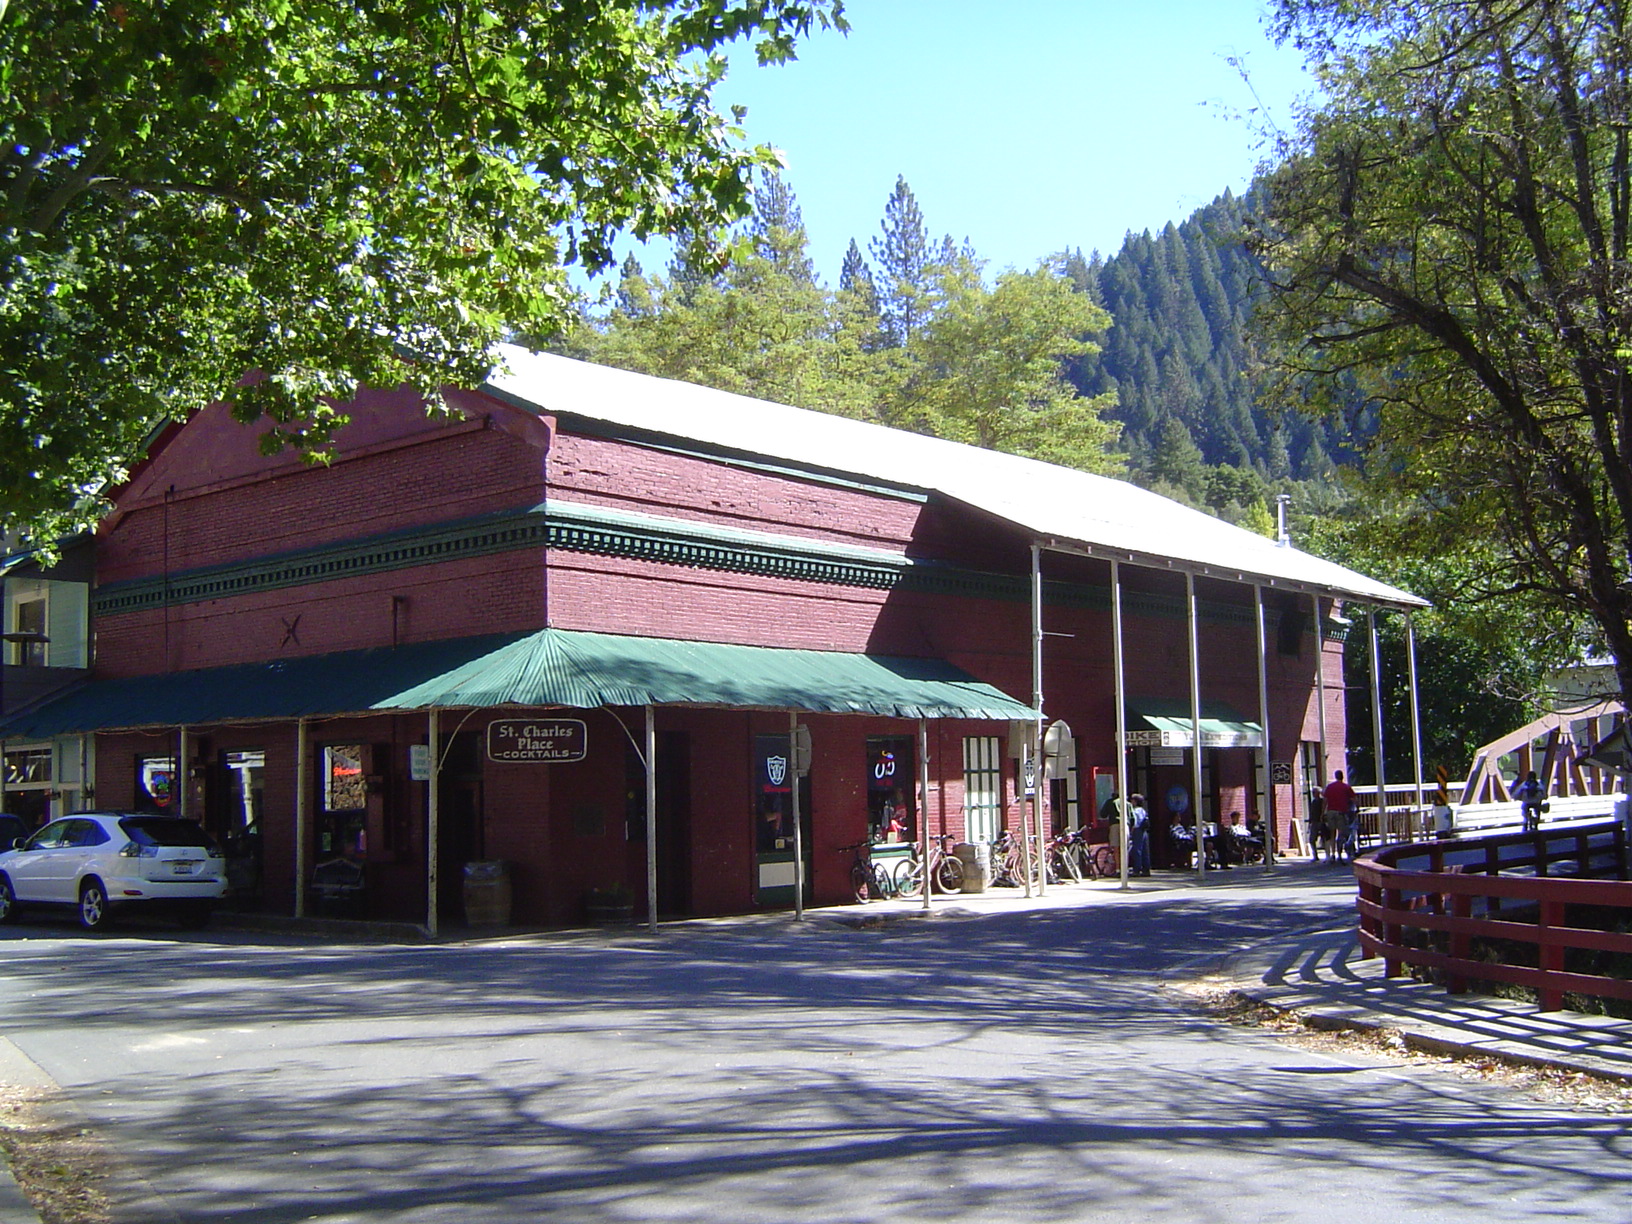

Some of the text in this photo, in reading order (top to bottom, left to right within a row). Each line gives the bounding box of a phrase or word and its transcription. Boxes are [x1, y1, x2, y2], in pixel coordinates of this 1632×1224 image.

[499, 725, 574, 738] St. Charles
[517, 737, 554, 750] Place
[502, 749, 570, 759] COCKTAILS
